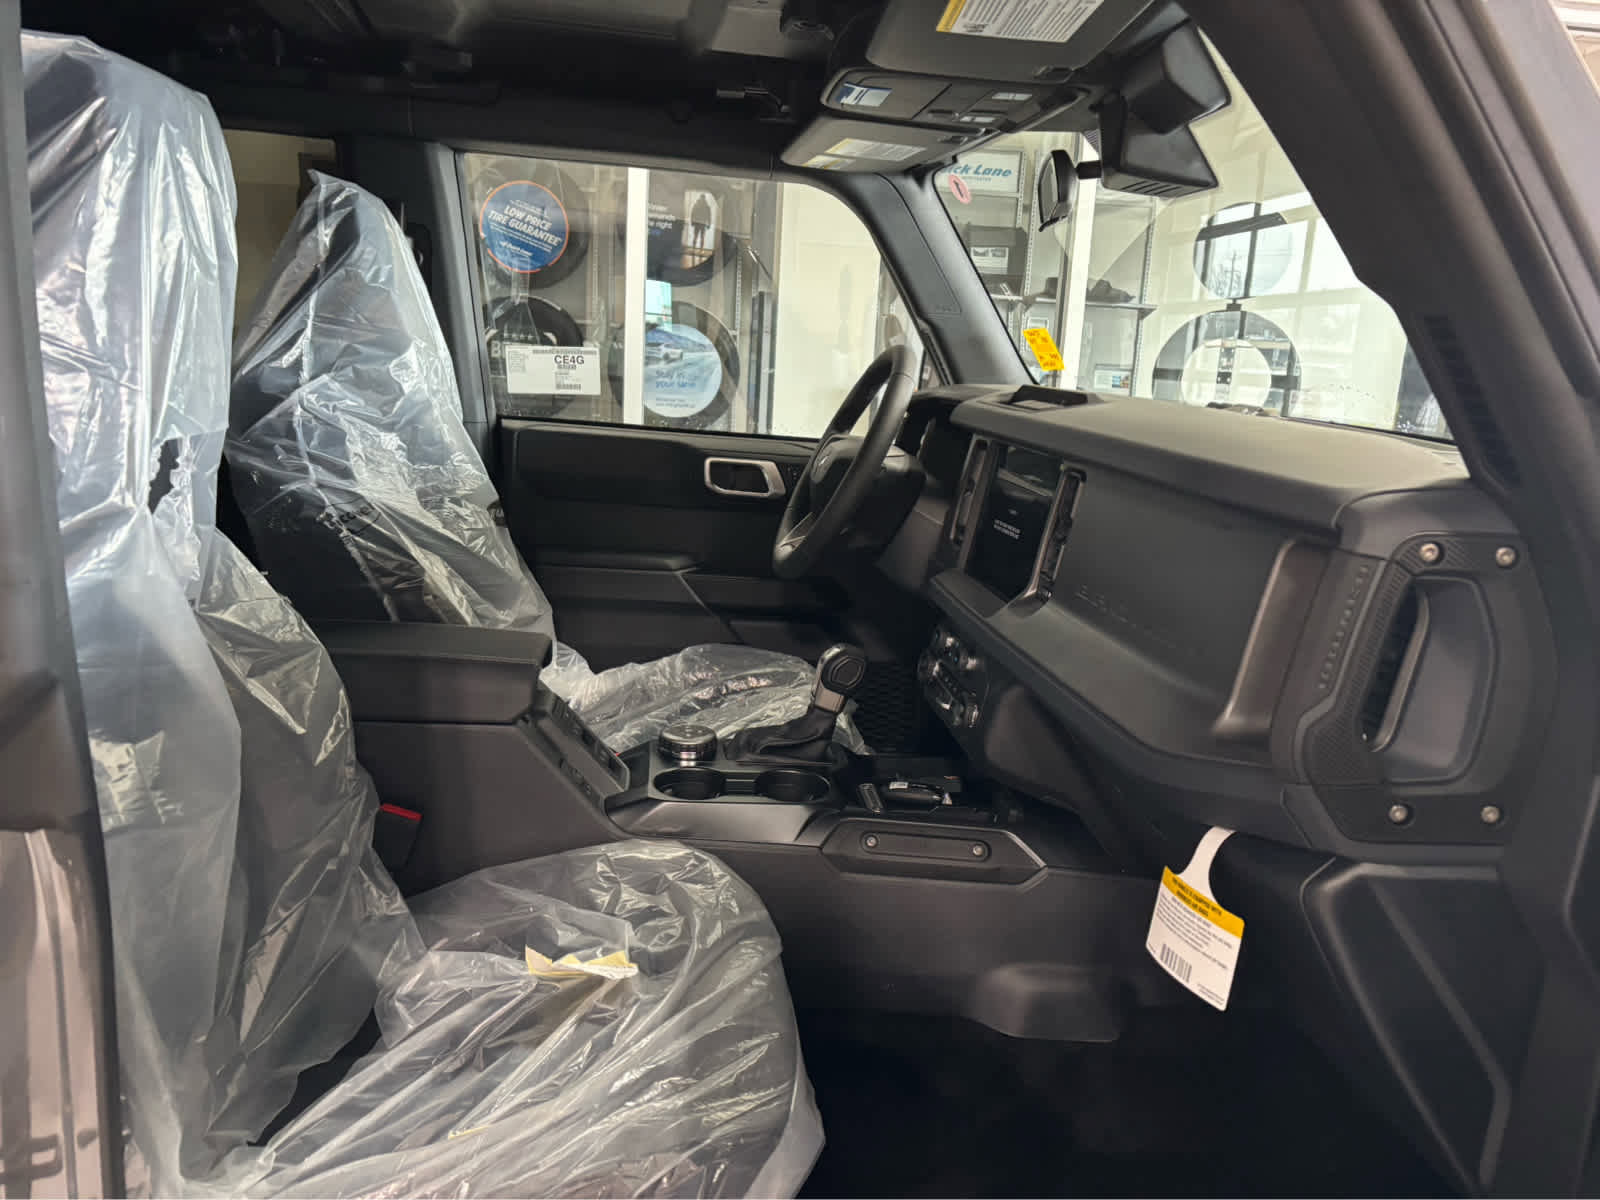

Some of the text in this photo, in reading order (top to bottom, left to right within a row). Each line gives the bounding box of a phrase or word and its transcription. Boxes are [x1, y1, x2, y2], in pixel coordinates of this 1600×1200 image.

[974, 164, 1012, 177] Lane
[488, 210, 509, 226] TIRE
[504, 205, 526, 219] LOW
[524, 214, 552, 231] PRICE
[554, 355, 585, 365] CE4G
